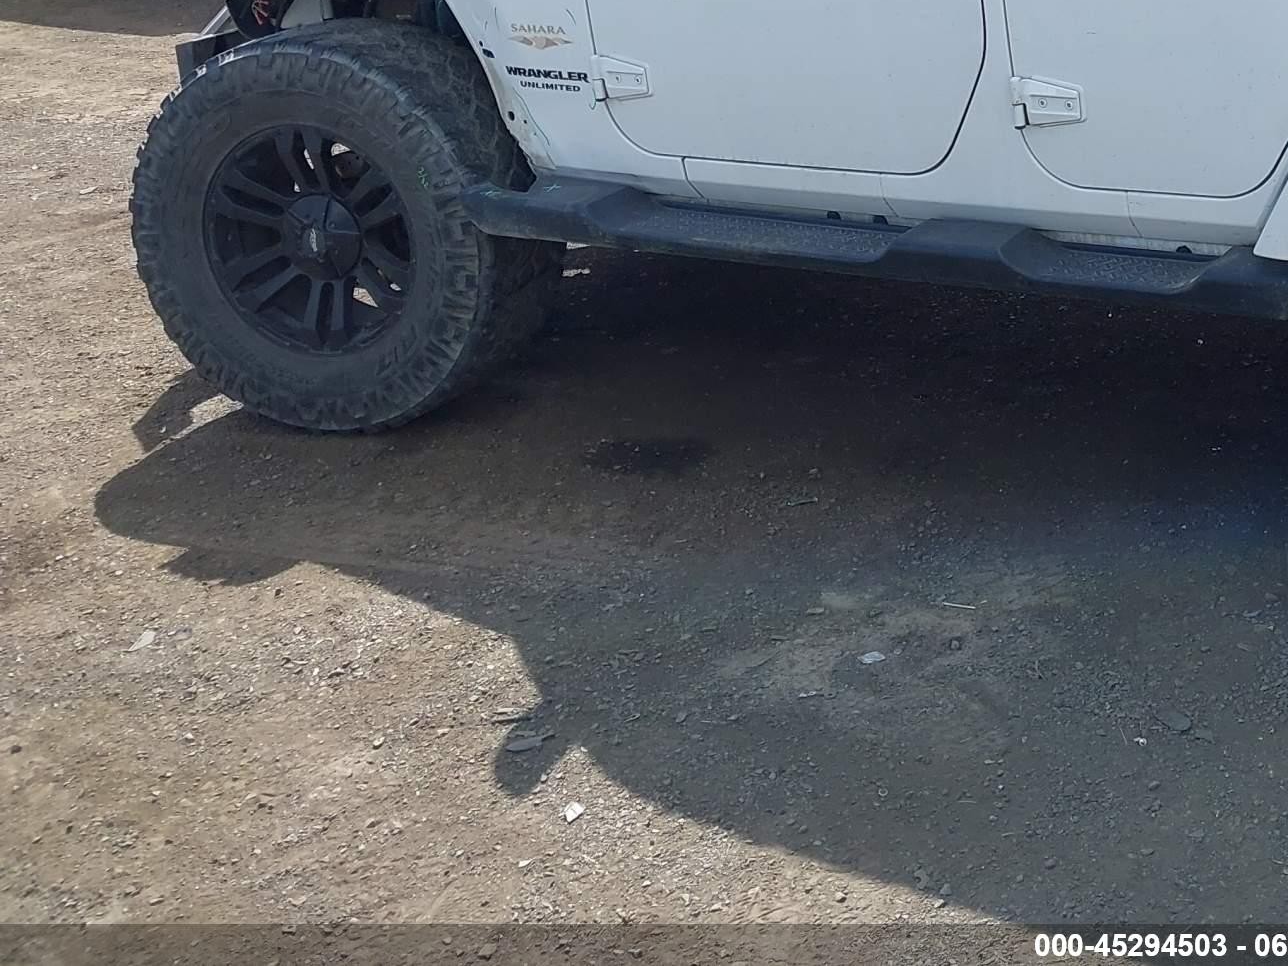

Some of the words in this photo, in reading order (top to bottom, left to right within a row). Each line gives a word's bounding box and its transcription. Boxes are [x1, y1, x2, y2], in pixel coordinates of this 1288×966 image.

[511, 23, 566, 35] SAHARA
[505, 65, 591, 83] WRANGLER
[519, 80, 581, 92] UNLIMITED
